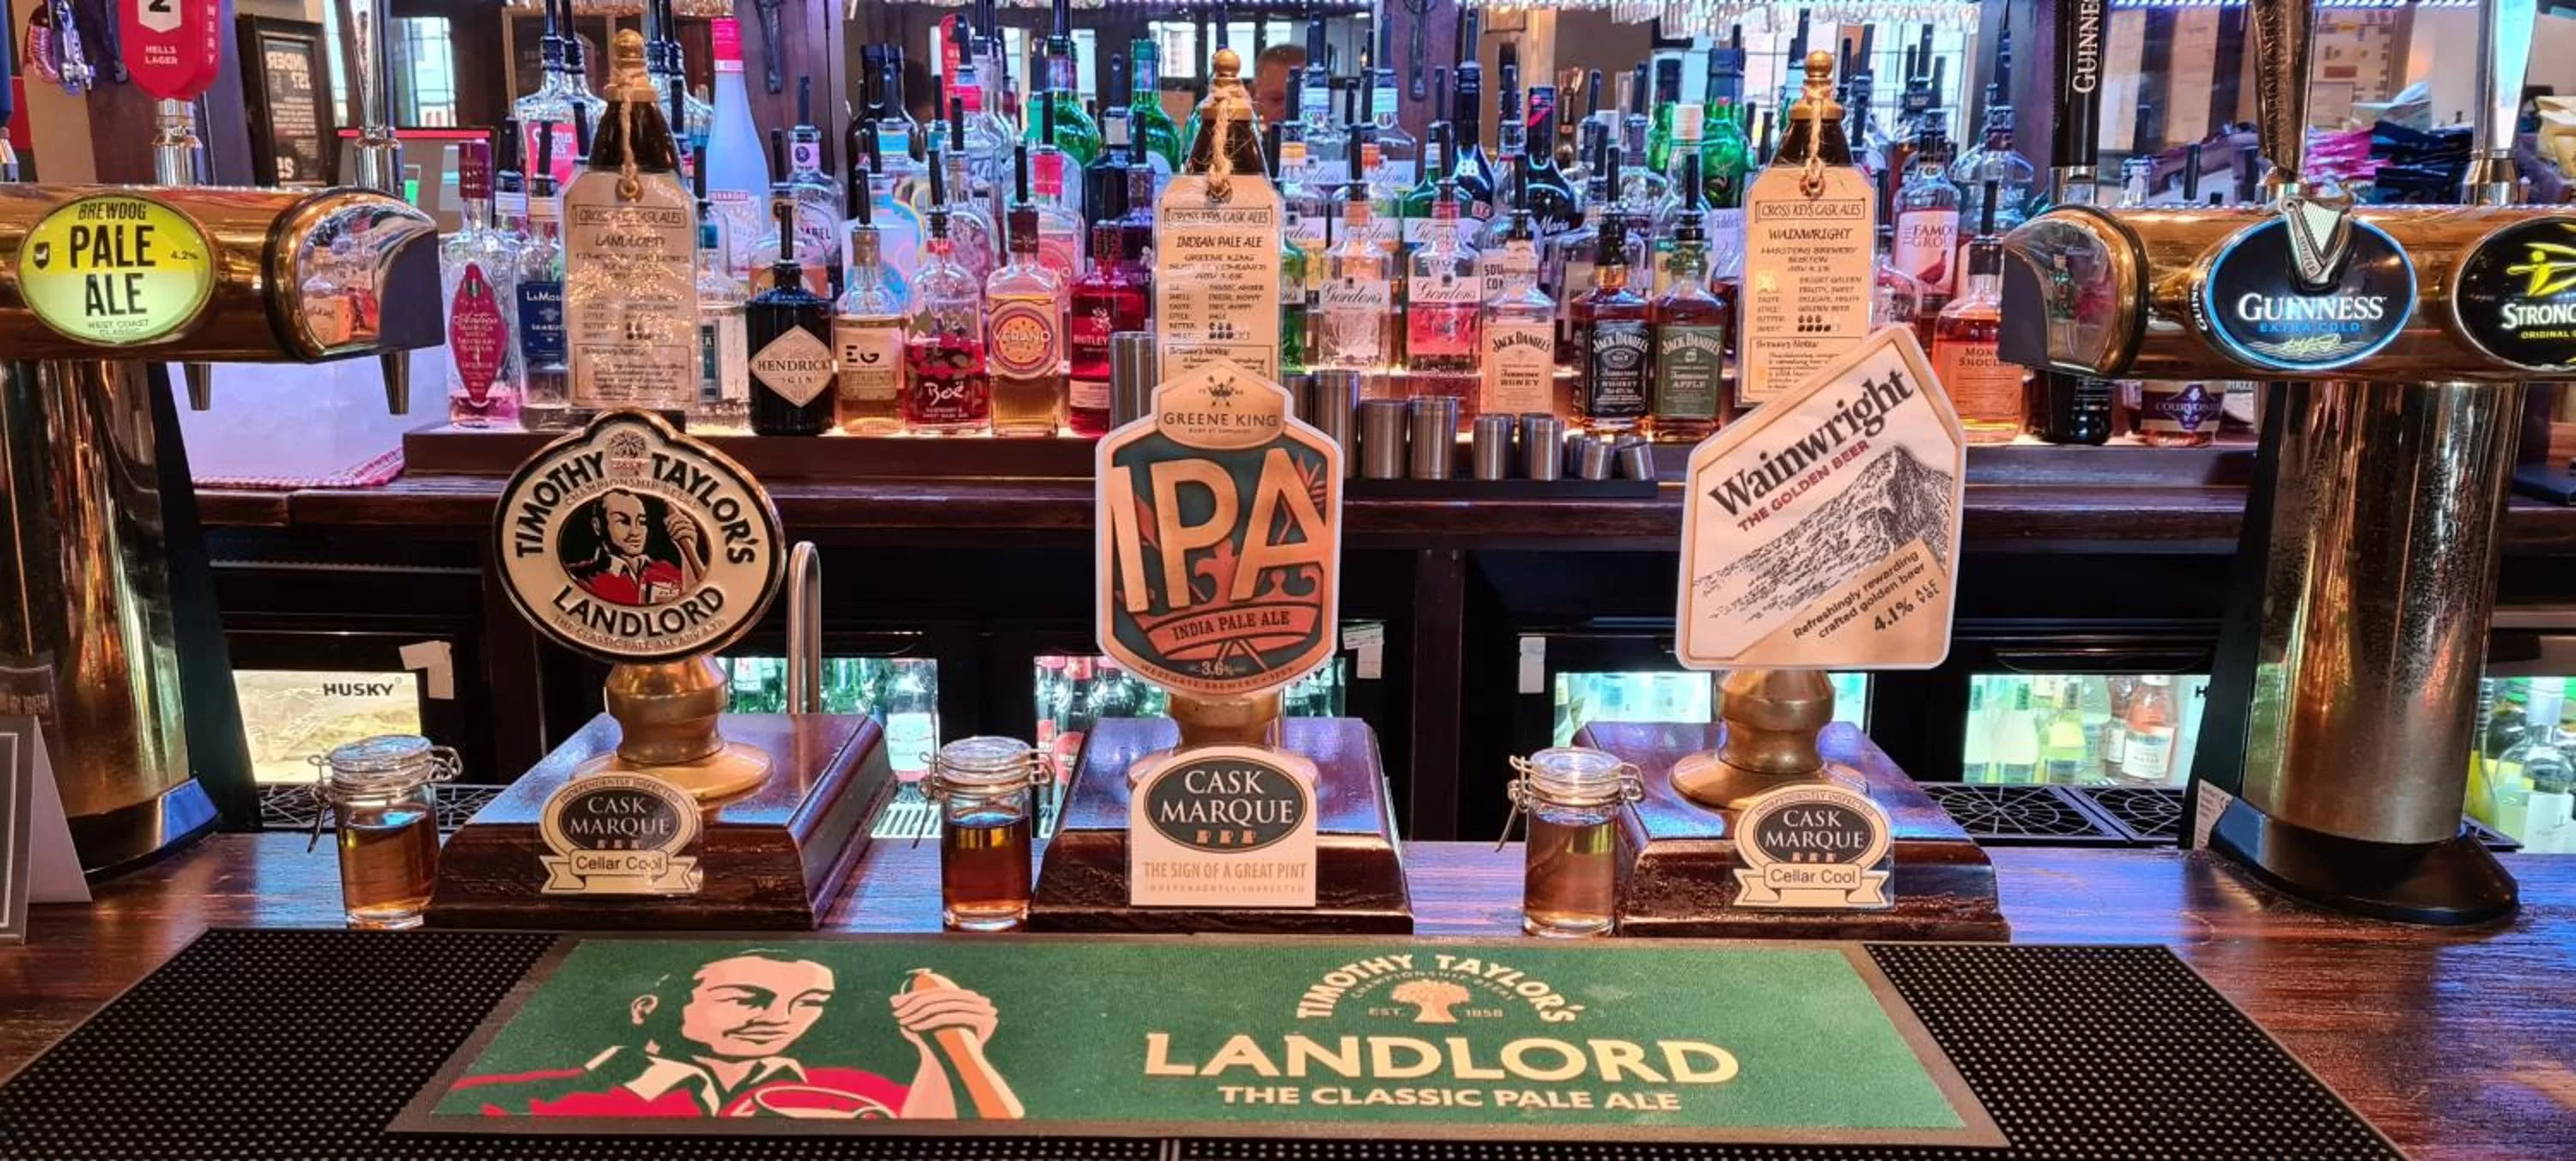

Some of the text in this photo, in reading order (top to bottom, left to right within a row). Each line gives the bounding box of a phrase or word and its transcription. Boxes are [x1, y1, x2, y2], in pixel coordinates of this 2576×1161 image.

[146, 46, 177, 54] HELLS
[145, 56, 178, 65] LAGER
[78, 202, 147, 221] BREWDOG
[1762, 204, 1791, 216] CROSS
[1839, 204, 1861, 216] ALES
[1176, 235, 1263, 248] INDIAN PALE ALE
[1769, 228, 1853, 240] WAINWRIGHT
[70, 225, 156, 269] PALE
[86, 273, 147, 317] ALE
[2239, 292, 2385, 321] GUINNESS
[2260, 322, 2360, 333] EXTRA COLD
[2521, 331, 2569, 339] ORIGINAL
[1493, 335, 1516, 353] JACK
[1594, 336, 1615, 354] JACK
[1662, 337, 1686, 355] JACK
[1163, 413, 1278, 428] GREENE KING
[1708, 367, 1914, 516] Wainwright
[1738, 440, 1870, 532] THE GOLDEN BEER
[516, 451, 757, 564] TIMOTHY TAYLOR'S
[1108, 447, 1335, 613] IPA
[1793, 551, 1919, 639] Refreshingly rewarding
[1818, 562, 1925, 639] crafted golden beer
[552, 585, 724, 637] LANDLORD
[1874, 597, 1915, 633] 4.1%
[1173, 611, 1291, 640] INDIA PALE ALE
[323, 683, 394, 696] HUSKY
[1185, 770, 1265, 794] CASK
[588, 797, 647, 814] CASK
[1160, 799, 1294, 826] MARQUE
[570, 817, 671, 836] MARQUE
[1783, 810, 1842, 827] CASK
[1765, 830, 1864, 849] MARQUE
[575, 856, 662, 870] Cellar Cool
[1145, 862, 1308, 878] THE SIGN OF A GREAT PINT
[1770, 868, 1856, 884] Cellar Cool
[1297, 954, 1587, 1023] TIMOTHY TAYLOR'S
[1368, 1006, 1504, 1018] EST. 1858
[1145, 1031, 1741, 1084] LANDLORD
[1218, 1085, 1682, 1111] THE CLASSIC PALE ALE
